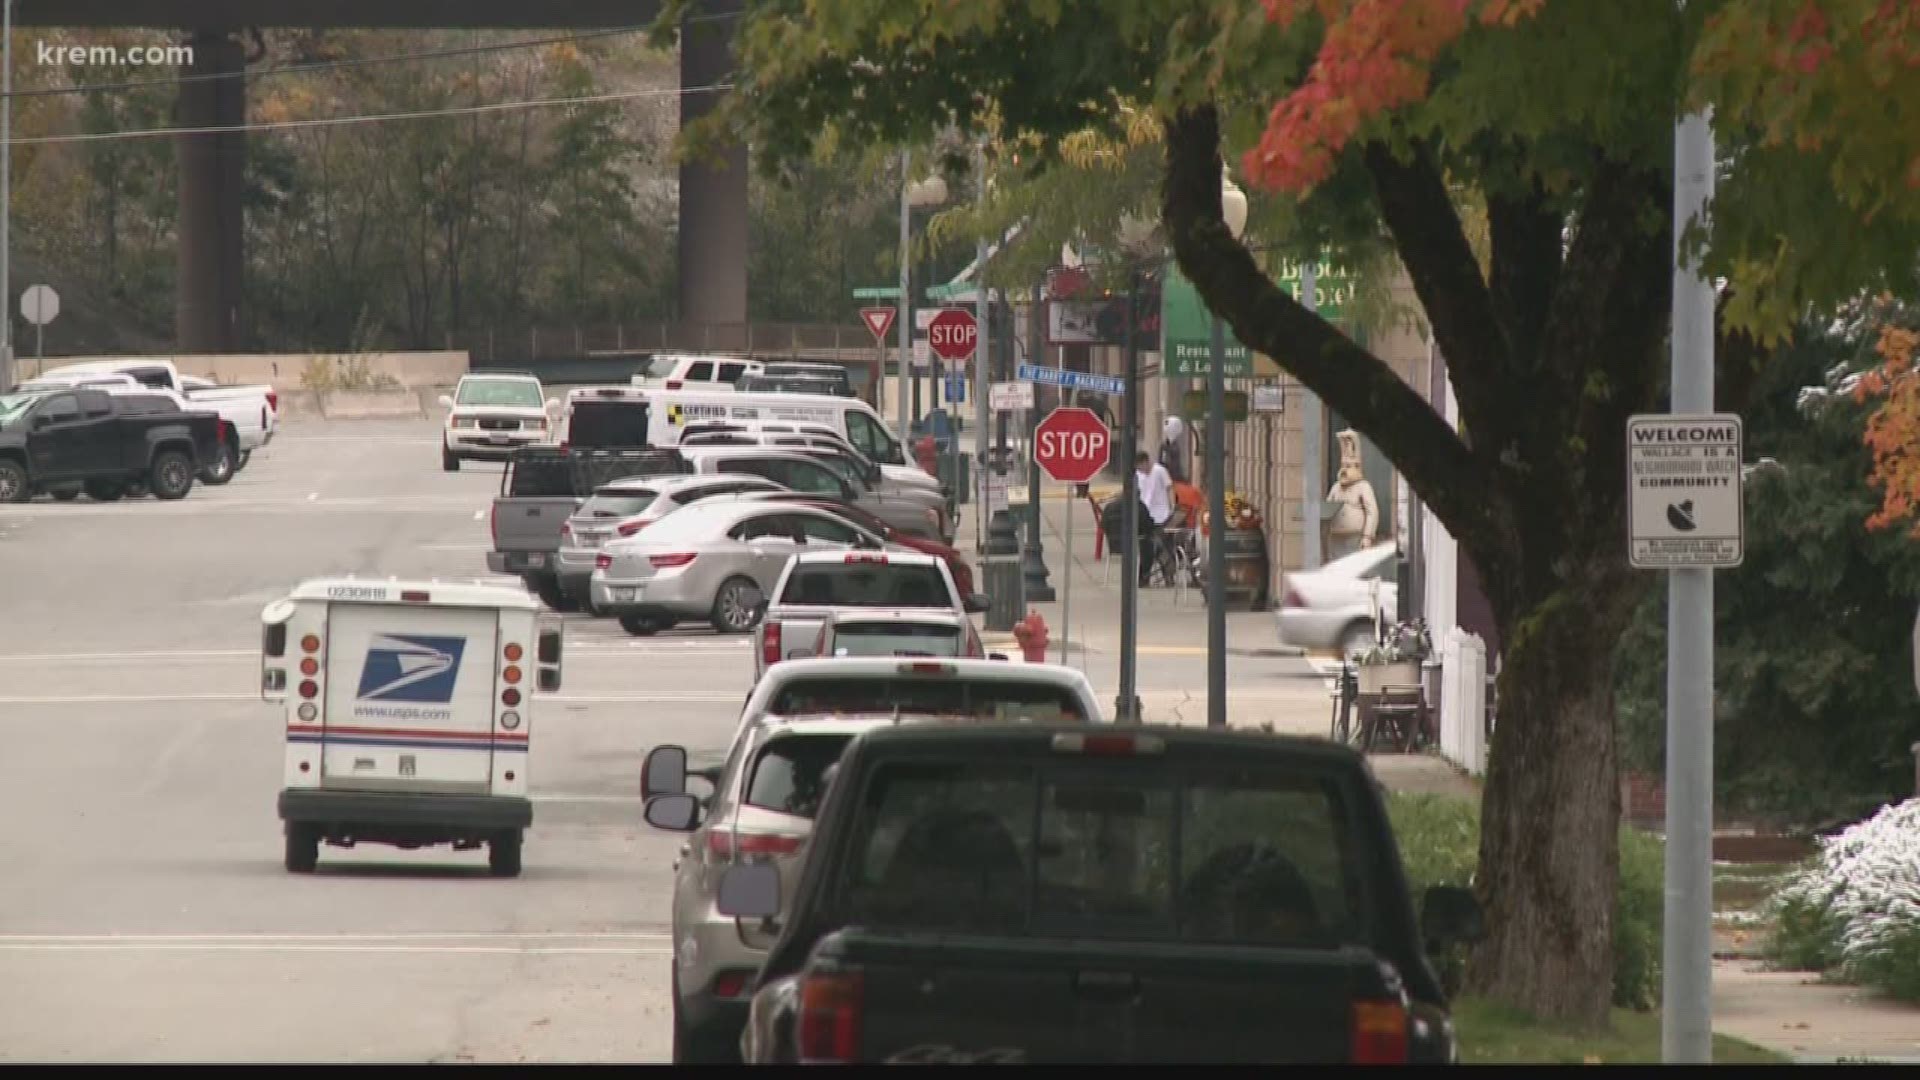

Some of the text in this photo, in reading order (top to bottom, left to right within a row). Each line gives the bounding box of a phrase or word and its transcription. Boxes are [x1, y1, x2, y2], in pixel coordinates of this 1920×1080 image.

[931, 324, 976, 345] STOP
[1176, 343, 1246, 358] Restaant
[683, 404, 727, 417] CERTIFIED
[1634, 427, 1736, 442] WELCOME
[1040, 431, 1105, 460] STOP
[1642, 446, 1735, 457] WALLACE IS A
[1640, 477, 1729, 488] COMMUNITY
[353, 706, 451, 721] www.usps.com
